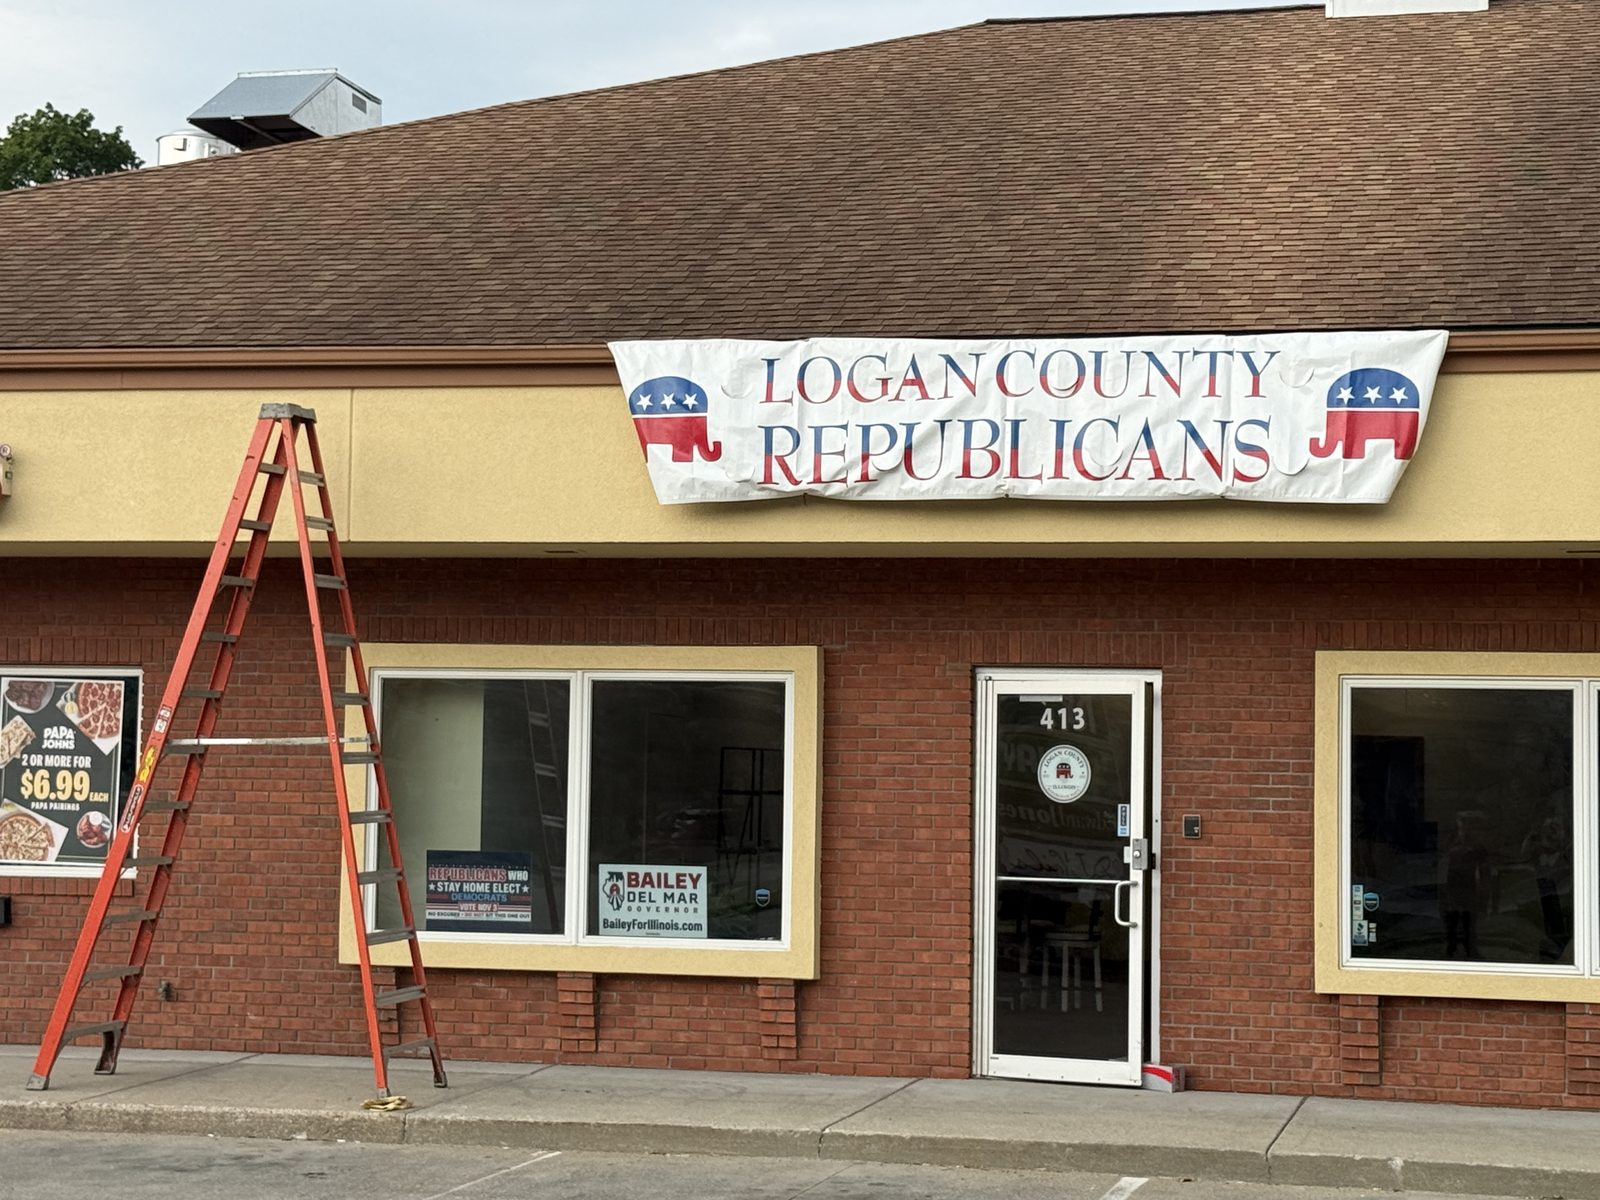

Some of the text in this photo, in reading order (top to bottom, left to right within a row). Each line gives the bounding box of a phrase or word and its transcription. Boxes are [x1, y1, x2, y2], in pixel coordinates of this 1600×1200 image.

[759, 347, 1280, 406] LOGAN COUNTY
[757, 414, 1272, 488] REPUBLICANS
[1040, 707, 1085, 730] 413
[43, 726, 75, 740] PAPA
[41, 740, 75, 750] JOHNS
[21, 754, 92, 768] 2 OR MORE FOR
[1044, 750, 1063, 767] LOGAN
[1064, 750, 1085, 768] COUNTY
[20, 768, 109, 803] $6.99 EACH
[31, 802, 80, 811] PAPA PAIRINGS
[428, 867, 529, 882] REPUBLICANS WHO
[627, 871, 702, 889] BAILEY
[437, 882, 521, 893] STAY HOME ELECT
[451, 893, 508, 902] DEMOCRATS
[627, 891, 699, 904] DEL MAR
[627, 905, 698, 914] GOVERNOR
[603, 918, 703, 932] BaileyForIllinois.com
